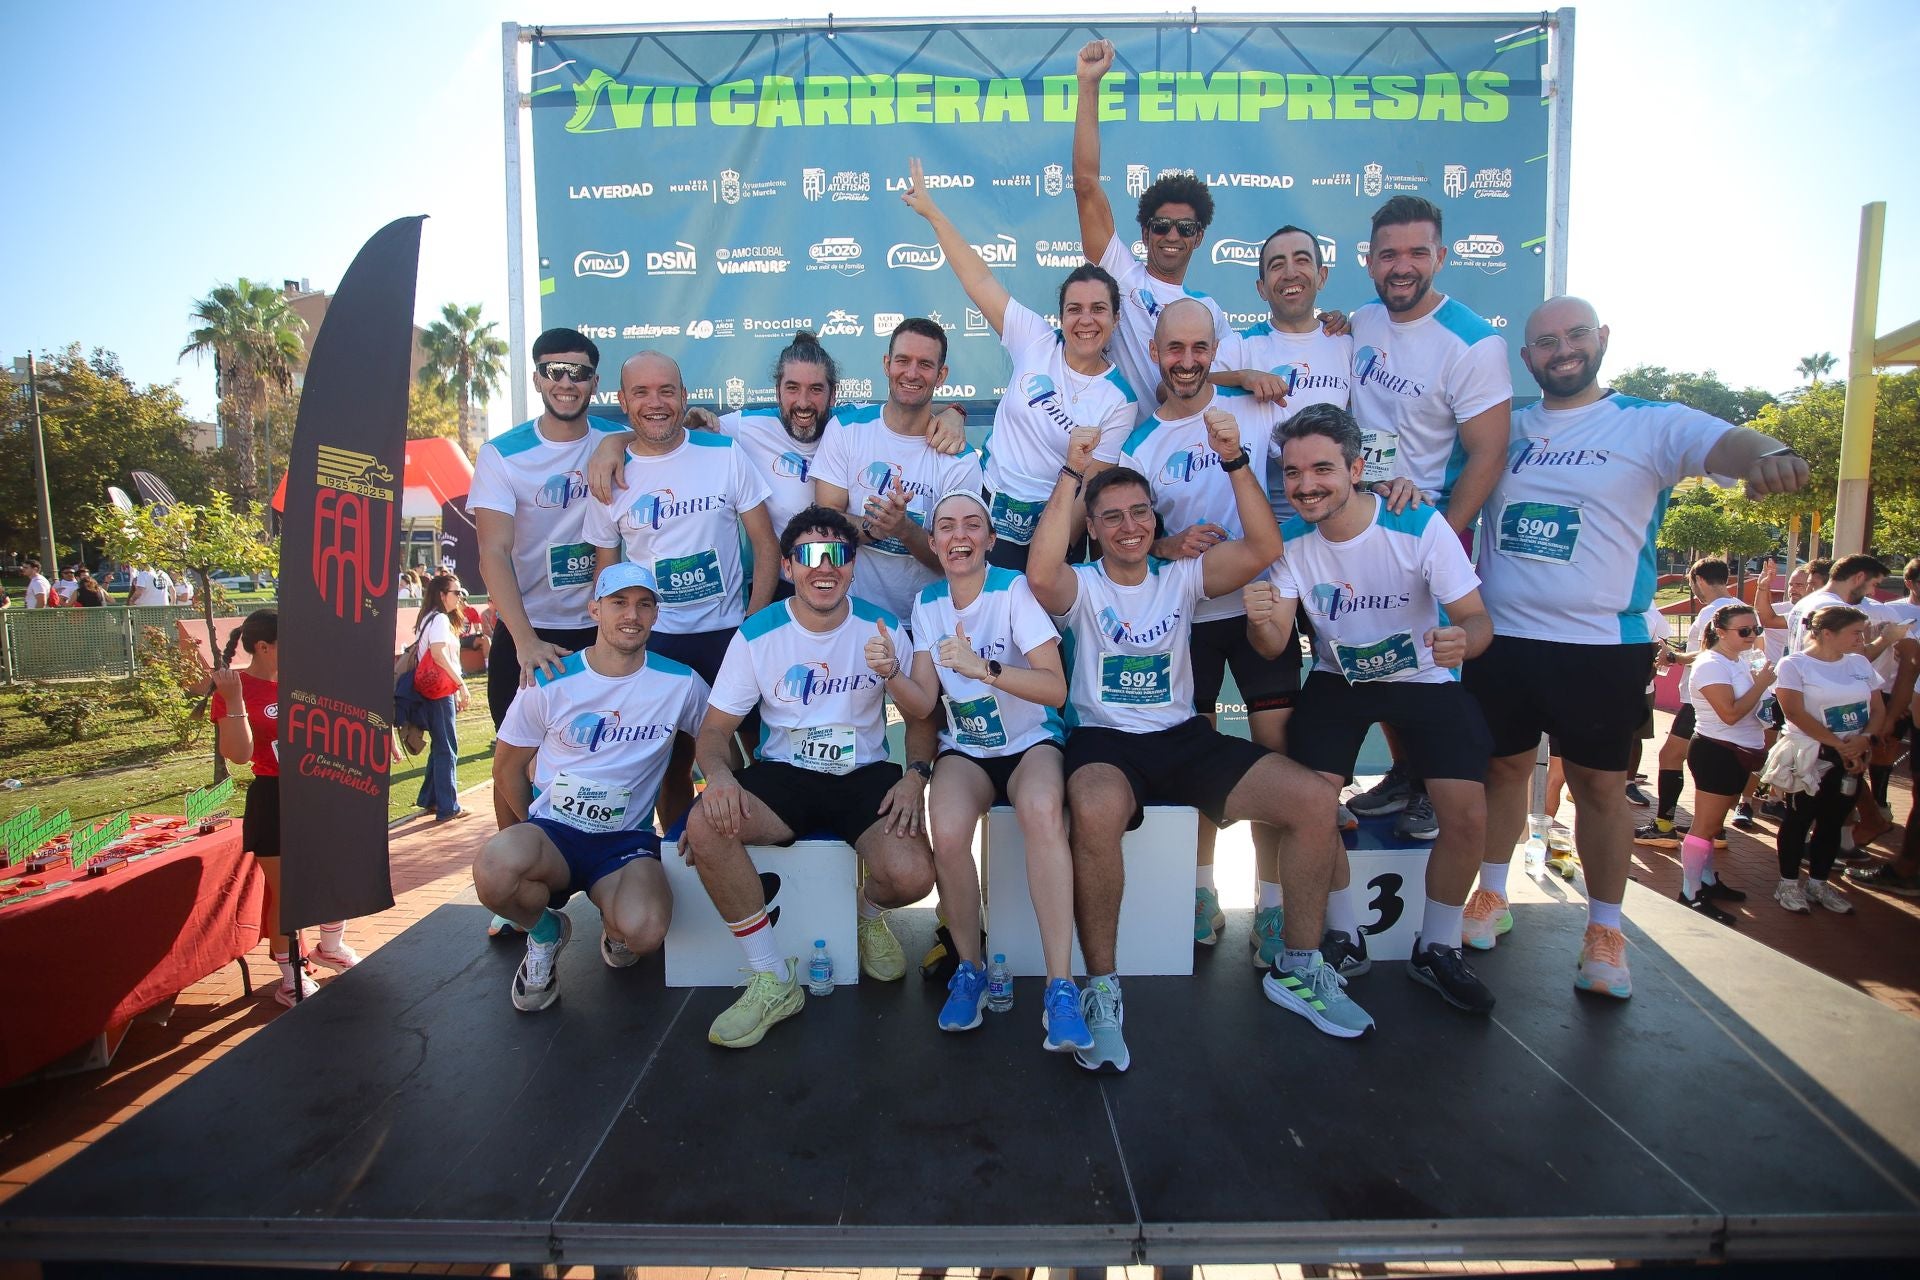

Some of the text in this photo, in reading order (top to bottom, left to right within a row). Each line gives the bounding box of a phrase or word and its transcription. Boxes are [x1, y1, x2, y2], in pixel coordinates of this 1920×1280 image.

[614, 70, 1510, 127] VII CARRERA DE EMPRESAS
[742, 180, 786, 190] Ayuntamiento
[886, 175, 975, 191] LA ERDAD
[1206, 174, 1229, 187] LA
[1230, 174, 1294, 188] VERDAD
[1385, 174, 1428, 183] Ayuntamiento
[569, 183, 654, 199] LA VERDAD
[753, 188, 776, 197] Murcia
[1394, 183, 1418, 191] Murcia
[731, 246, 784, 258] AMC GLOBAL
[1051, 241, 1073, 251] AMC
[1220, 245, 1260, 258] VIDAL
[582, 258, 622, 270] VIDAL
[647, 251, 696, 270] DSM
[896, 251, 939, 262] VIDAL
[622, 324, 680, 337] atalayas
[743, 317, 812, 330] Brocalsa
[747, 388, 777, 396] Ayuntami
[934, 385, 976, 397] RDAD
[757, 395, 776, 403] Murci
[324, 477, 386, 499] 1925 2025
[1517, 518, 1559, 538] 890
[670, 568, 705, 588] 896
[1356, 649, 1397, 669] 895
[1120, 671, 1158, 687] 892
[317, 696, 367, 720] ATLETISMO
[1215, 702, 1248, 713] Broc
[960, 715, 987, 731] 899
[288, 703, 391, 773] FAMU
[801, 740, 841, 760] 2170
[299, 752, 380, 796] Corriendo
[562, 796, 612, 821] 2168
[1360, 873, 1404, 936] 3
